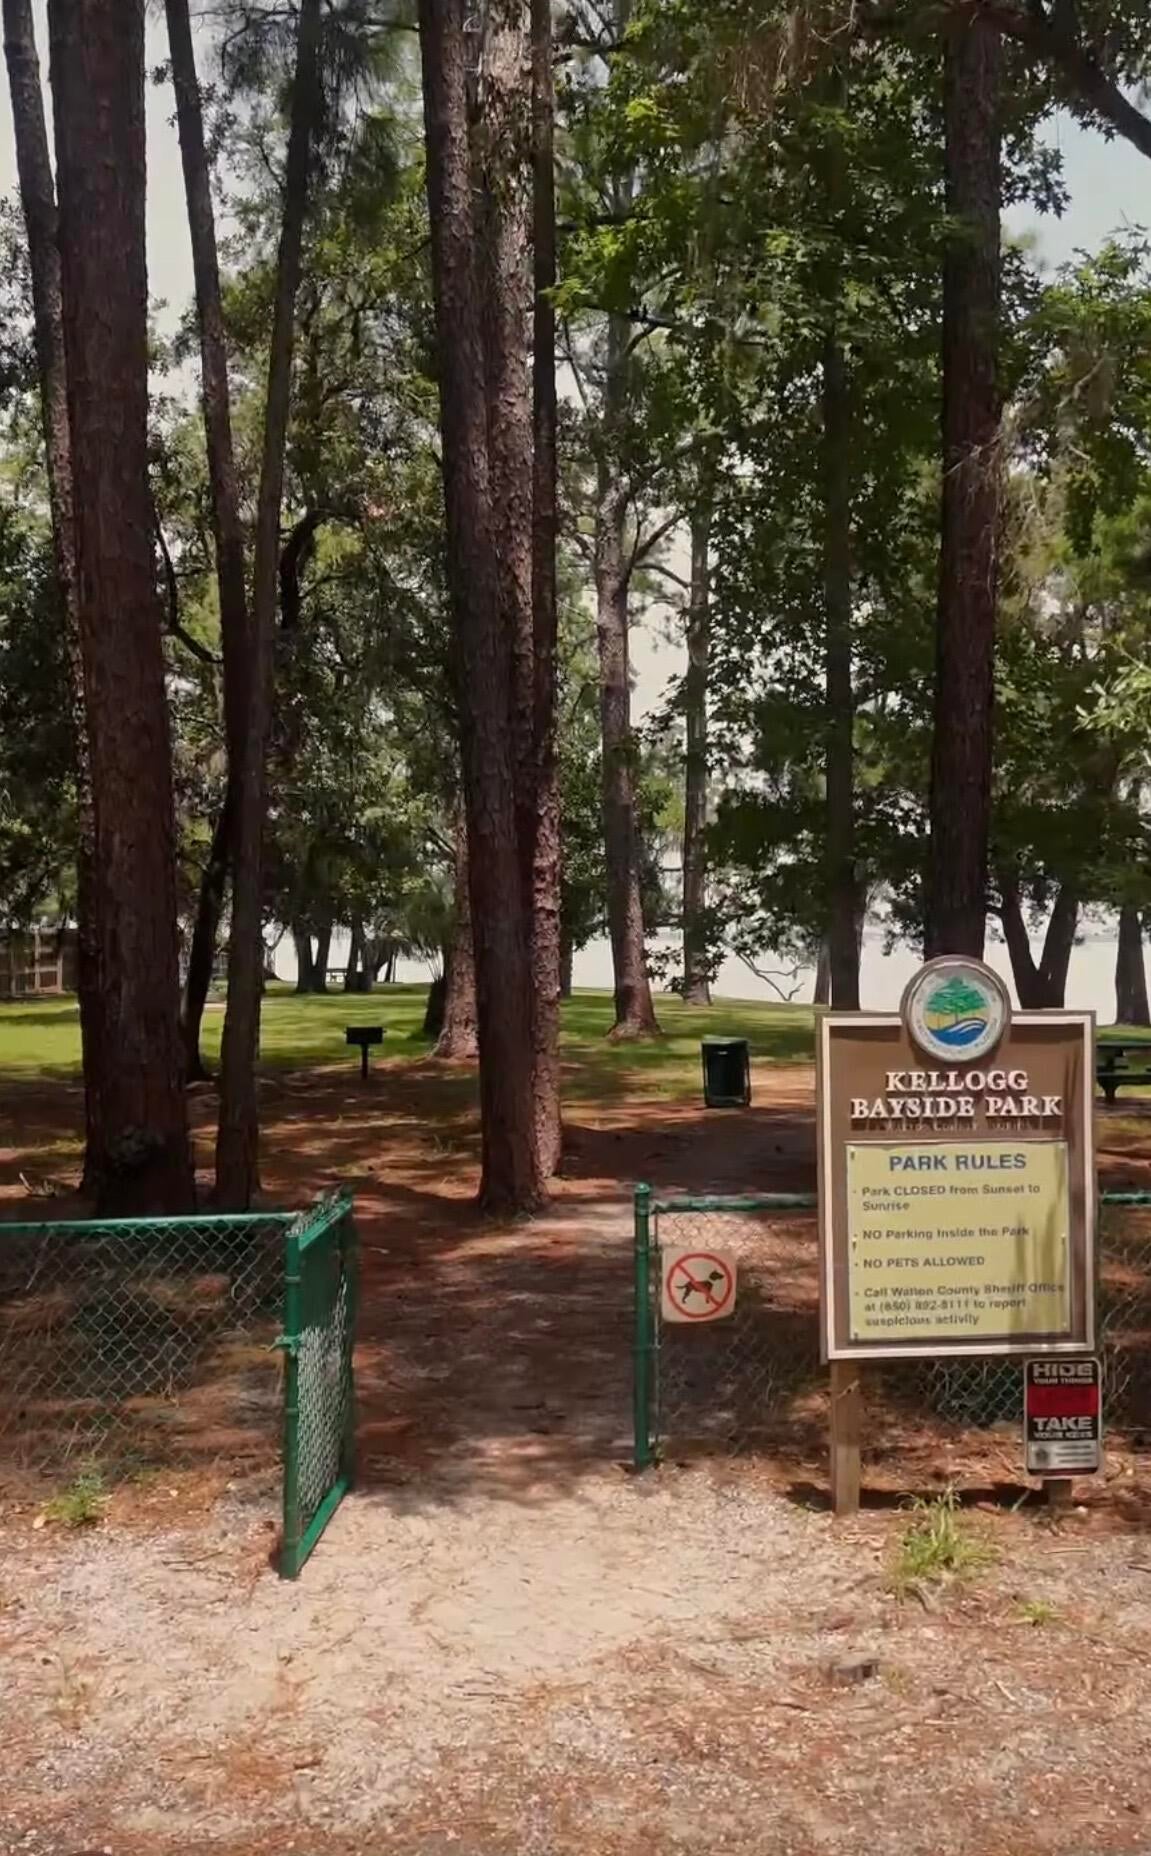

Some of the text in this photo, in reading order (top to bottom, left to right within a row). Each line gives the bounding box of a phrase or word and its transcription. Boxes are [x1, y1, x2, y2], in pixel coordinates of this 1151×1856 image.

[886, 1070, 1029, 1092] KELLOGG
[850, 1095, 1063, 1119] BAYSIDE PARK
[889, 1153, 1026, 1171] PARK RULES
[862, 1183, 1040, 1197] Park CLOSED from Sunset to
[862, 1201, 910, 1211] Sunrise
[863, 1226, 1030, 1242] NO Parking Inside the Park
[863, 1256, 985, 1269] NO PETS ALLOWED
[864, 1287, 887, 1297] Call
[891, 1286, 934, 1296] Walton
[937, 1285, 979, 1296] County
[865, 1302, 876, 1312] at
[973, 1299, 985, 1309] to
[989, 1298, 1026, 1310] report
[865, 1314, 979, 1328] suspicious activity
[1033, 1364, 1092, 1376] HIDE
[1033, 1417, 1092, 1430] TAKE
